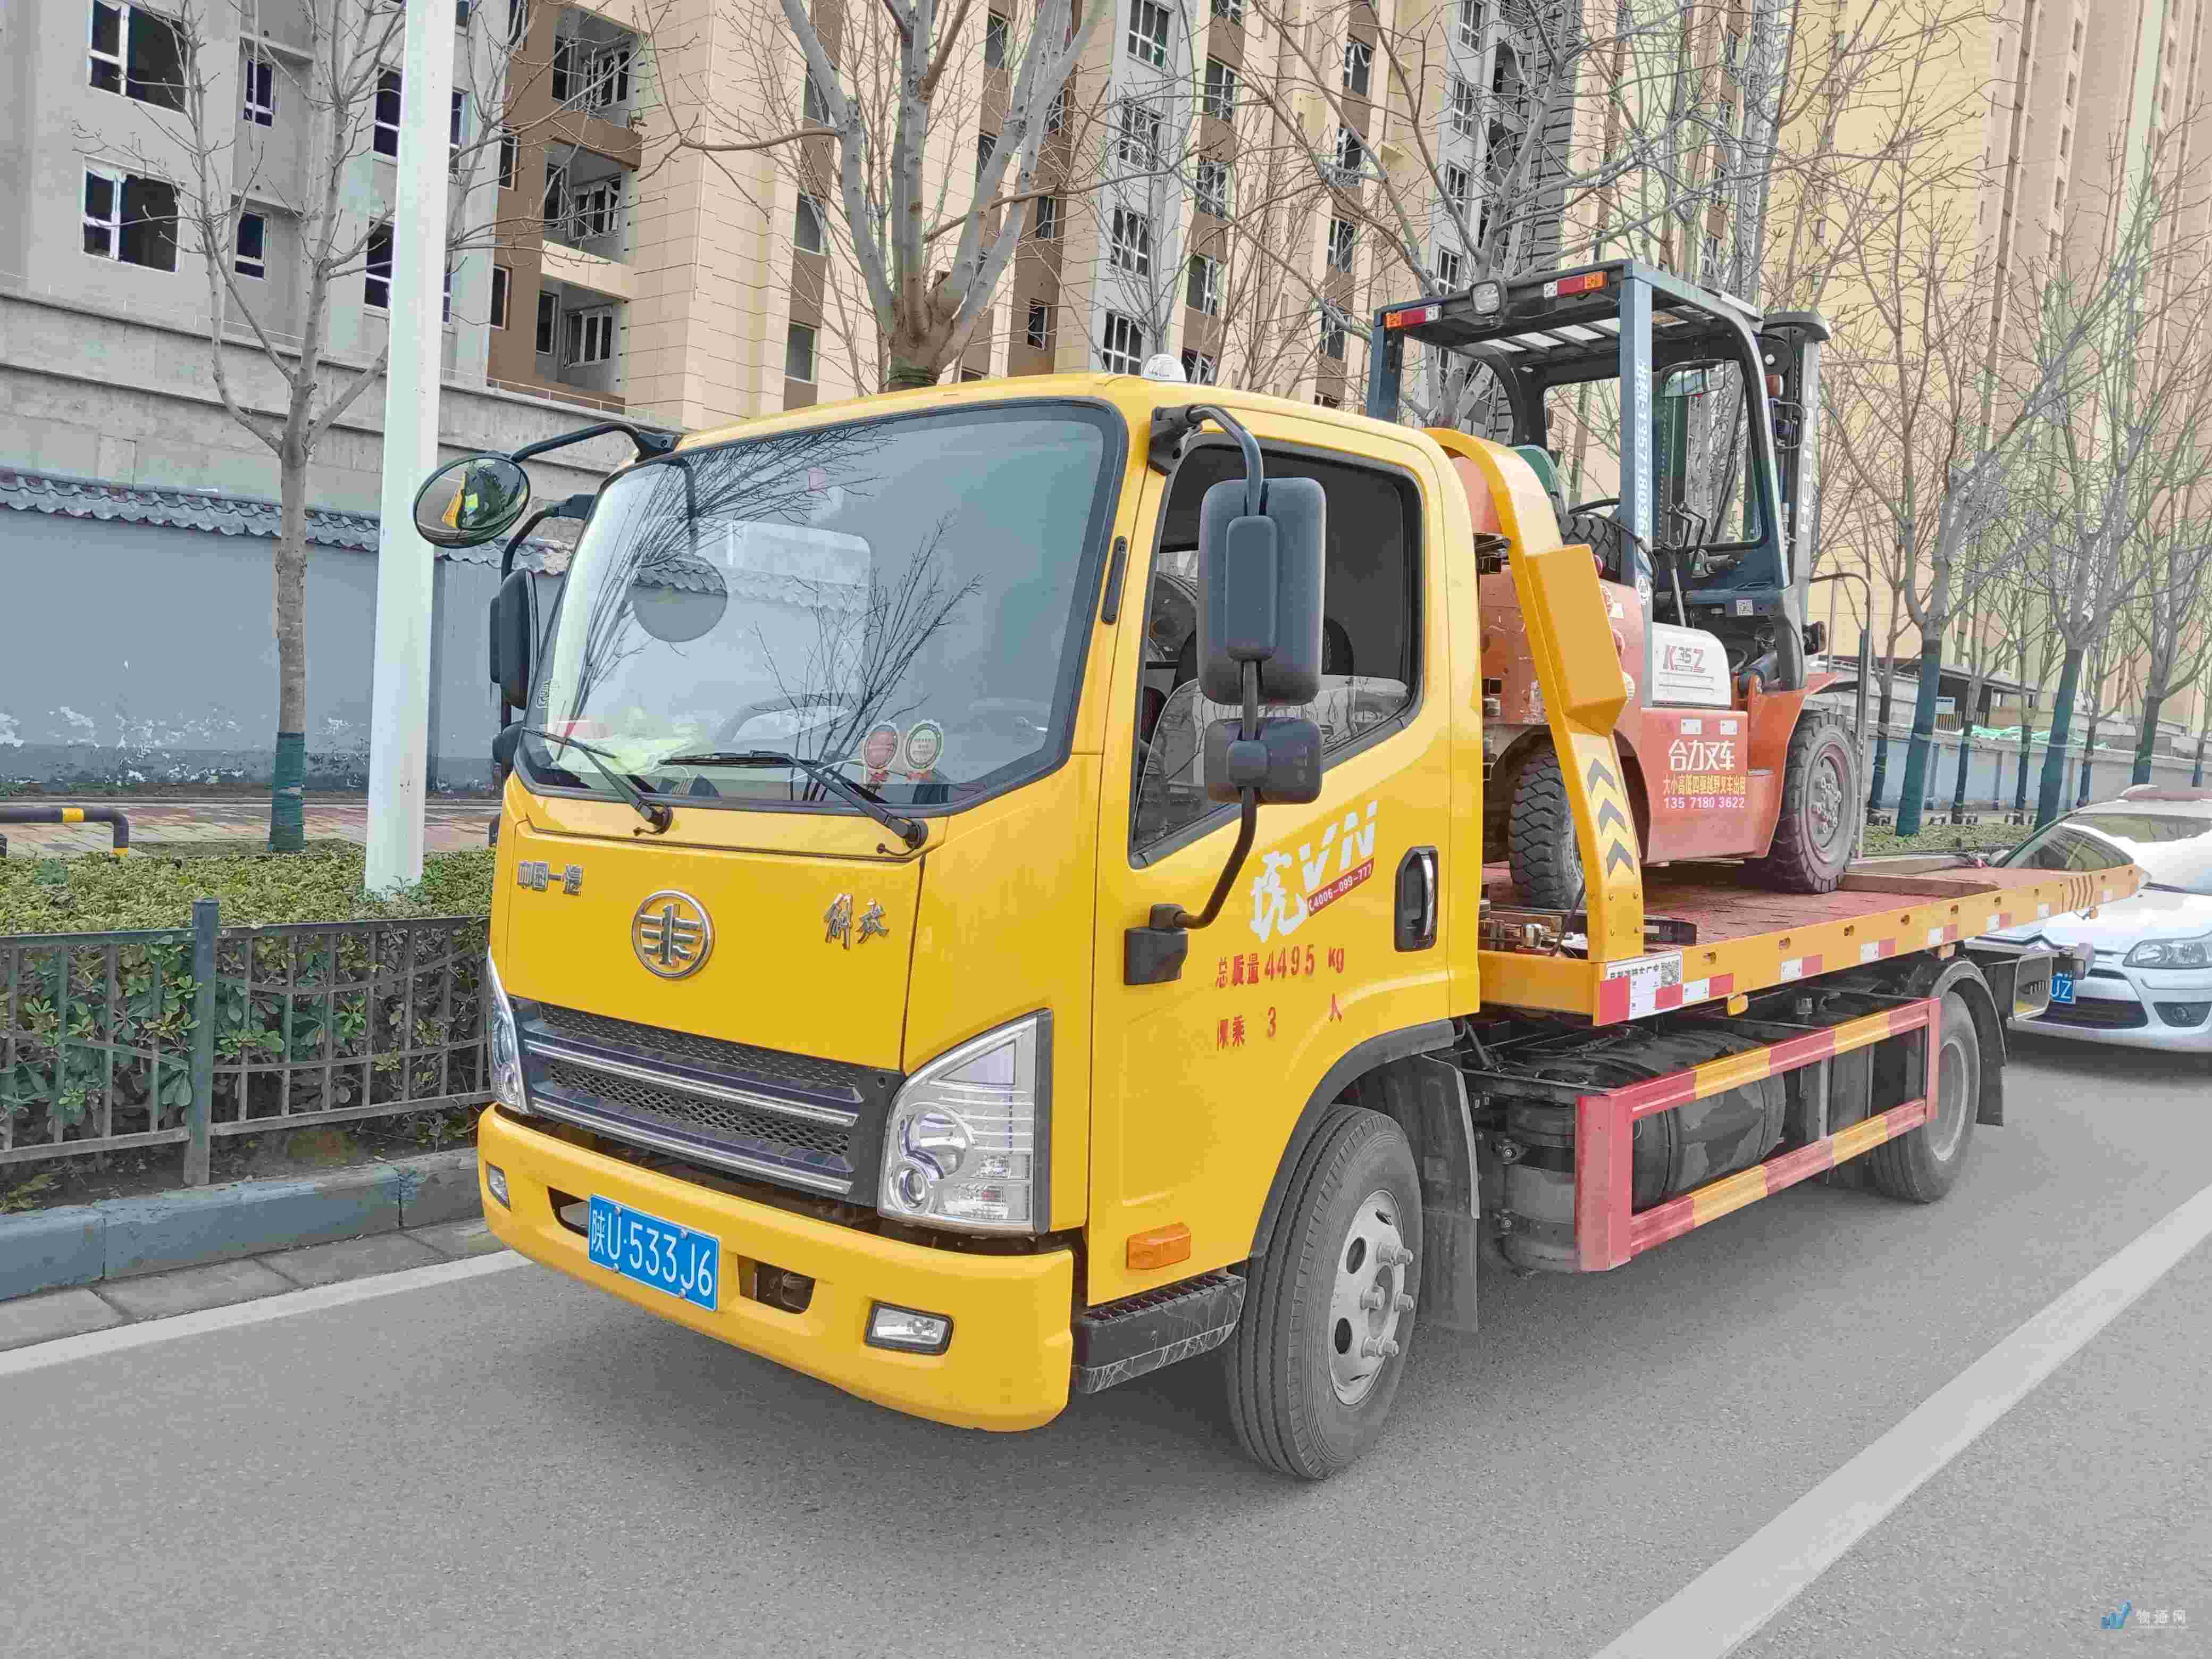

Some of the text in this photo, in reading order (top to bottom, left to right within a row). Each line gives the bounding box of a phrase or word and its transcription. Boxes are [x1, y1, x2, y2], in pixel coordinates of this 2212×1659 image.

[1669, 740, 1735, 770] 合力叉车
[1664, 797, 1745, 808] 135 7180 3622
[824, 893, 889, 950] 解放
[1268, 1006, 1276, 1038] 3
[1329, 993, 1343, 1023] 人
